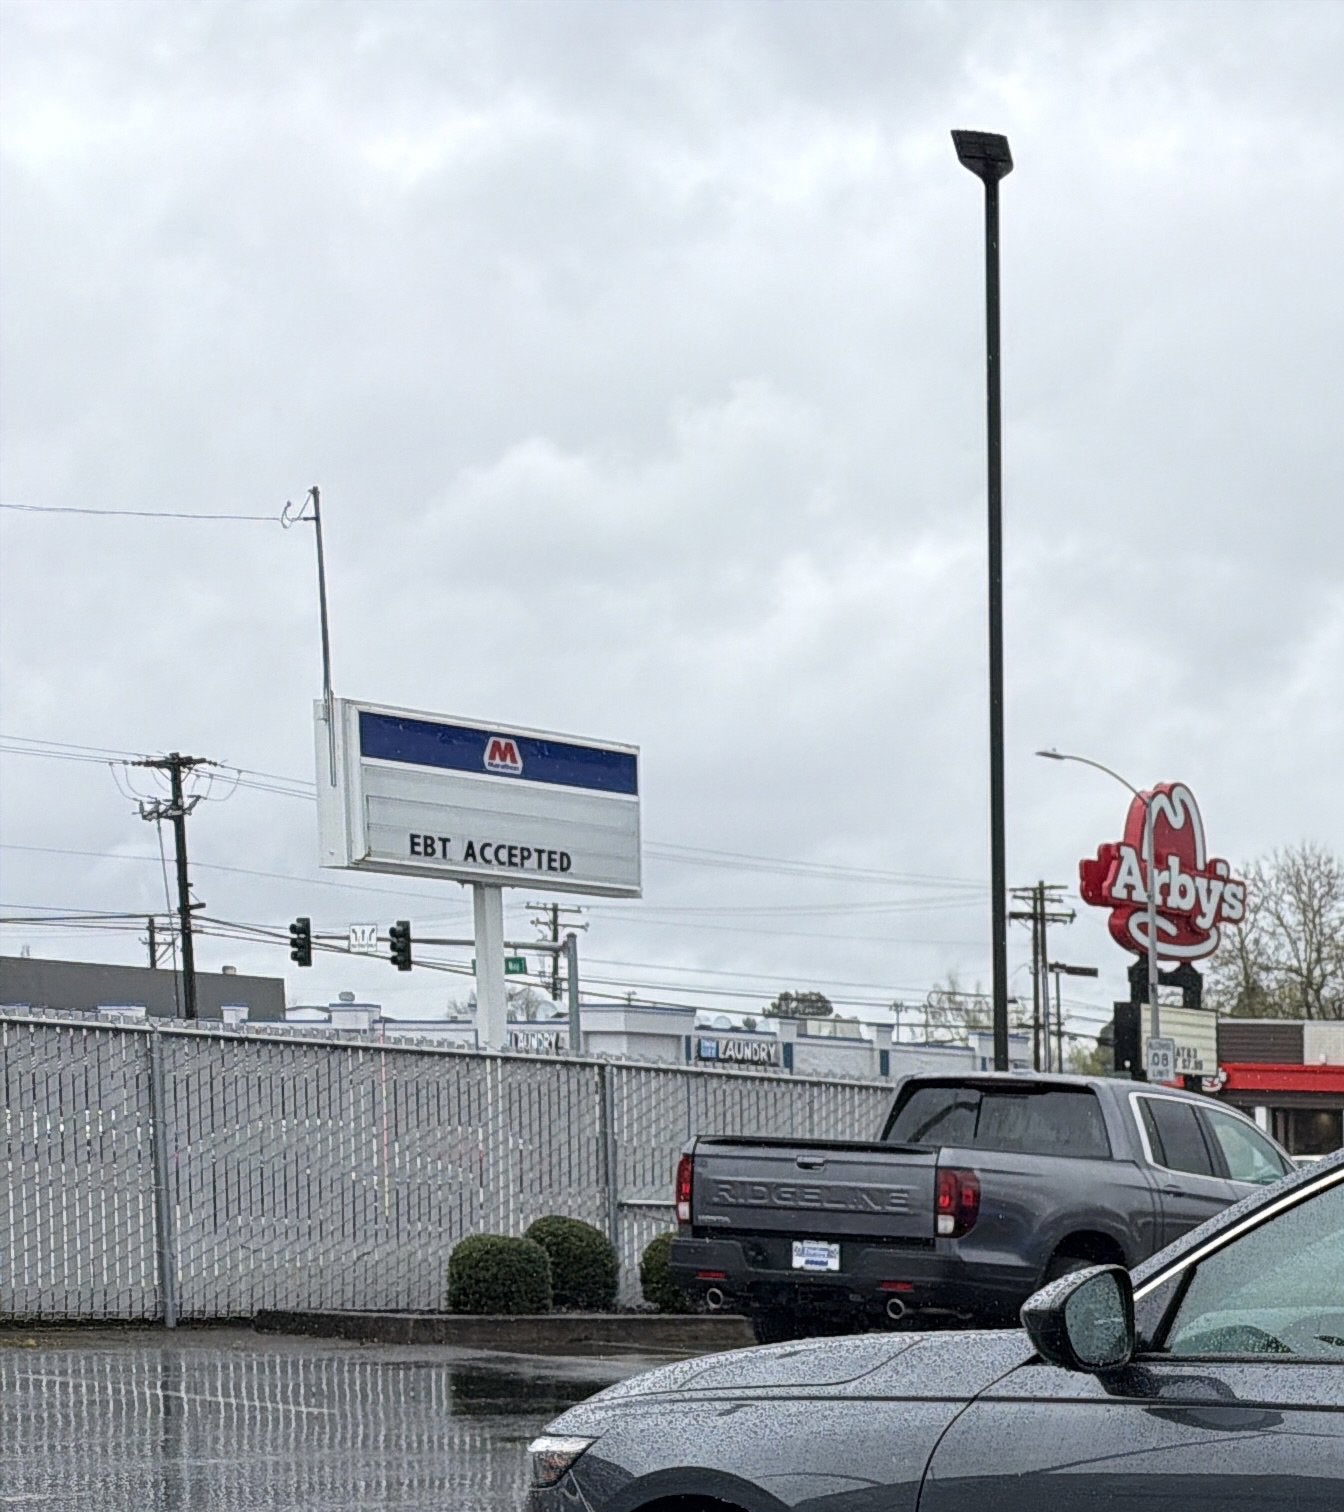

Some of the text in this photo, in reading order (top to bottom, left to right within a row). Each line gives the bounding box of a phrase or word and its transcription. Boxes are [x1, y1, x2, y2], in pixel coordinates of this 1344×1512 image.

[409, 833, 572, 872] EBT ACCEPTED
[1111, 845, 1245, 929] Arby's
[718, 1039, 777, 1063] LAUNDRY
[712, 1184, 910, 1213] RIDGELINE
